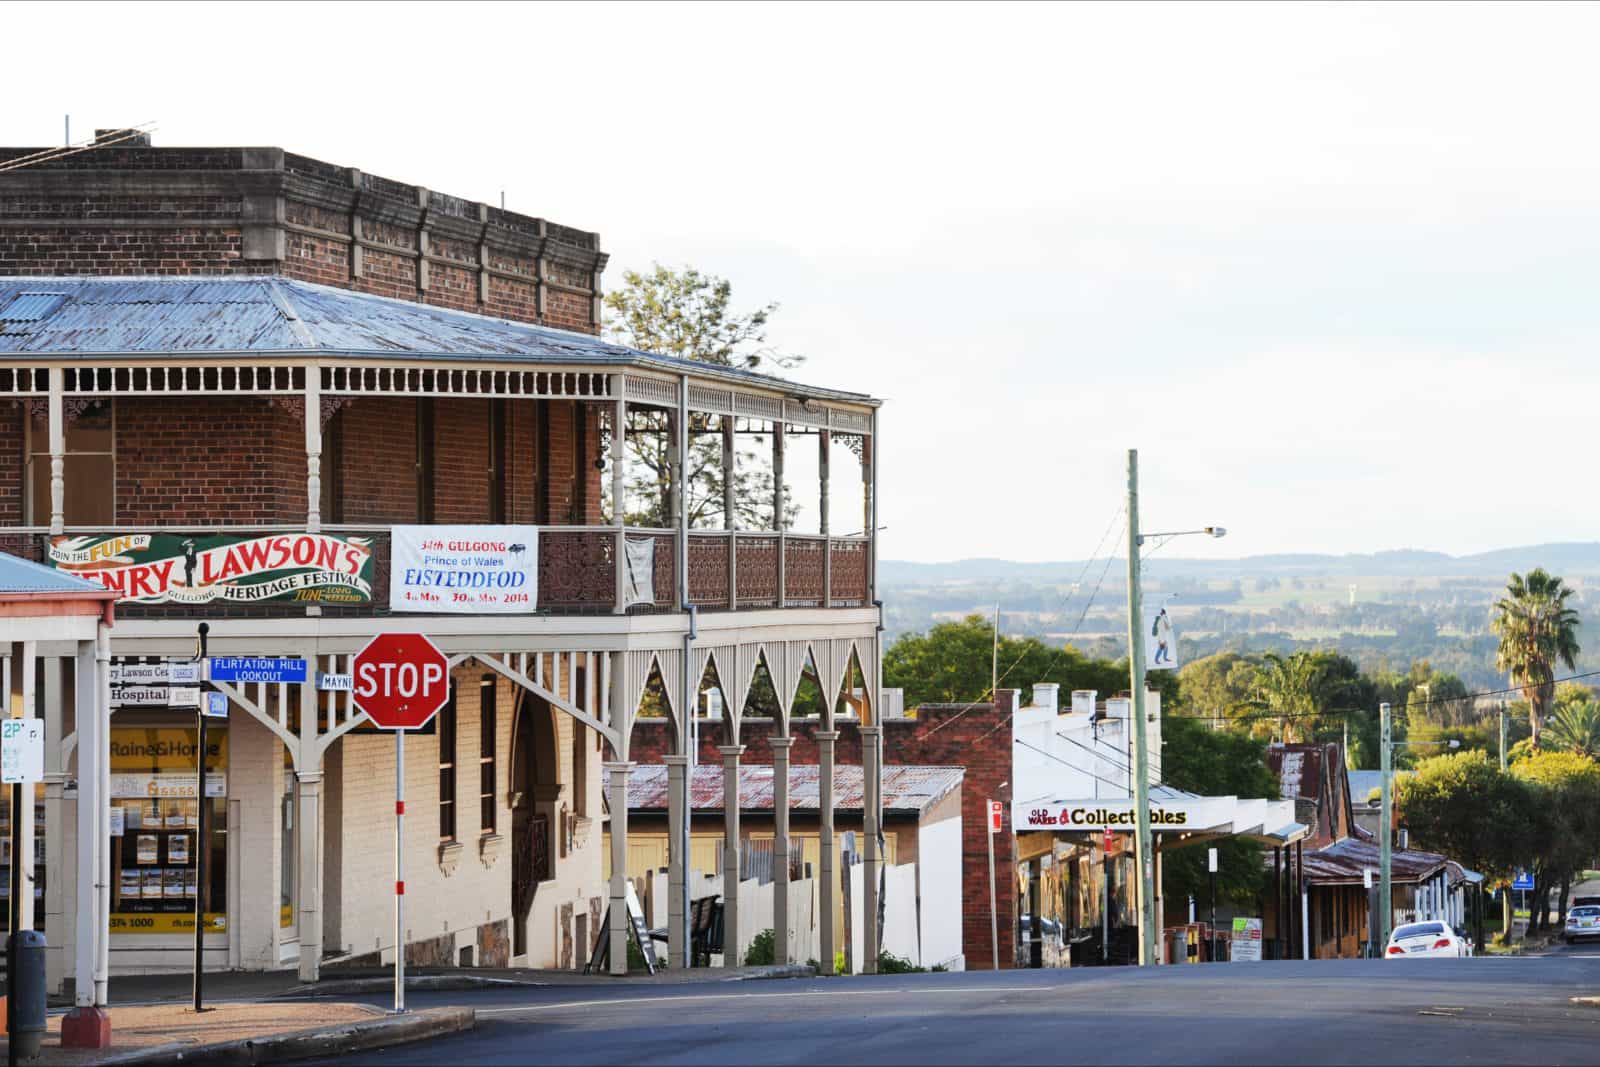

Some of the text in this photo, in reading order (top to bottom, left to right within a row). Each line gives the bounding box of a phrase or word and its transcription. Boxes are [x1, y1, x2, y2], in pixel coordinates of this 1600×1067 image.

[51, 534, 146, 561] JOIN THE FUN OF
[448, 541, 506, 552] GULGONG
[70, 535, 361, 598] NRY LAWSON'S
[424, 555, 504, 567] Prince of Wales
[224, 570, 360, 599] HERITAGE FESTIVAL
[404, 568, 525, 588] EISTEDDFOD
[503, 593, 529, 603] 2014
[121, 665, 152, 678] Lawson
[215, 659, 304, 671] FLIRTATION HILL
[235, 671, 283, 681] LOOKOUT
[359, 663, 443, 698] STOP
[111, 688, 166, 702] Hospital
[4, 723, 20, 738] 2P
[1071, 808, 1187, 825] Collectbles
